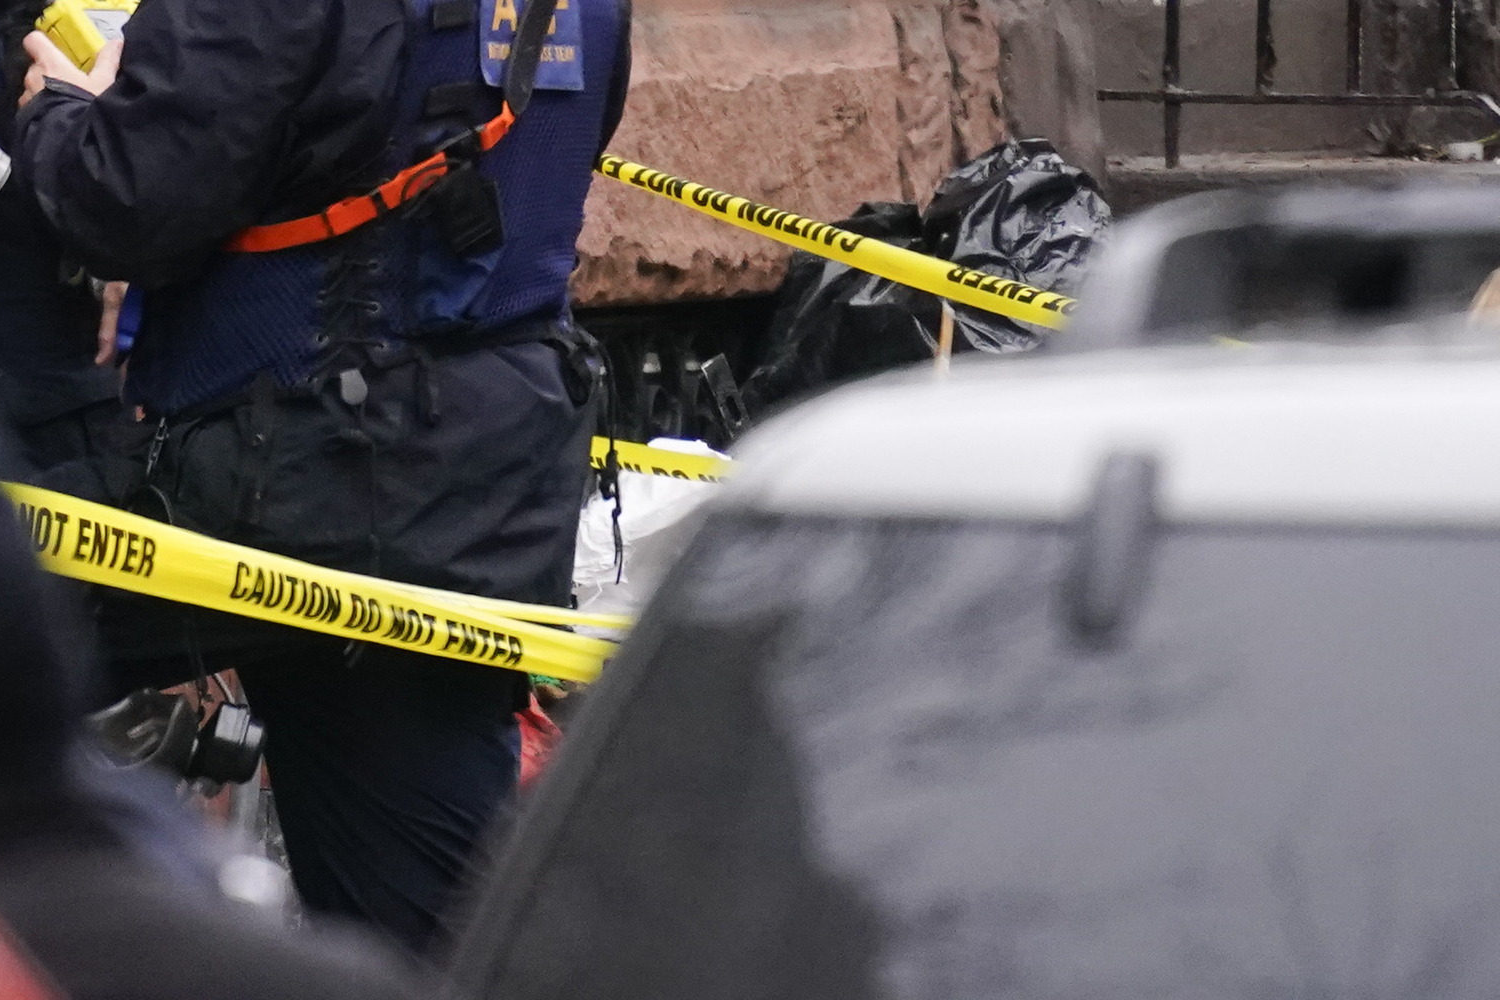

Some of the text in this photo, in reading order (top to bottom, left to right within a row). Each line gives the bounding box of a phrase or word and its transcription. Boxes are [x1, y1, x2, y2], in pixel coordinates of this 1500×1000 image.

[629, 168, 865, 253] CAUTION DO NOT
[73, 517, 156, 578] ENTER
[230, 561, 524, 665] CAUTION DO NOT ENTER
